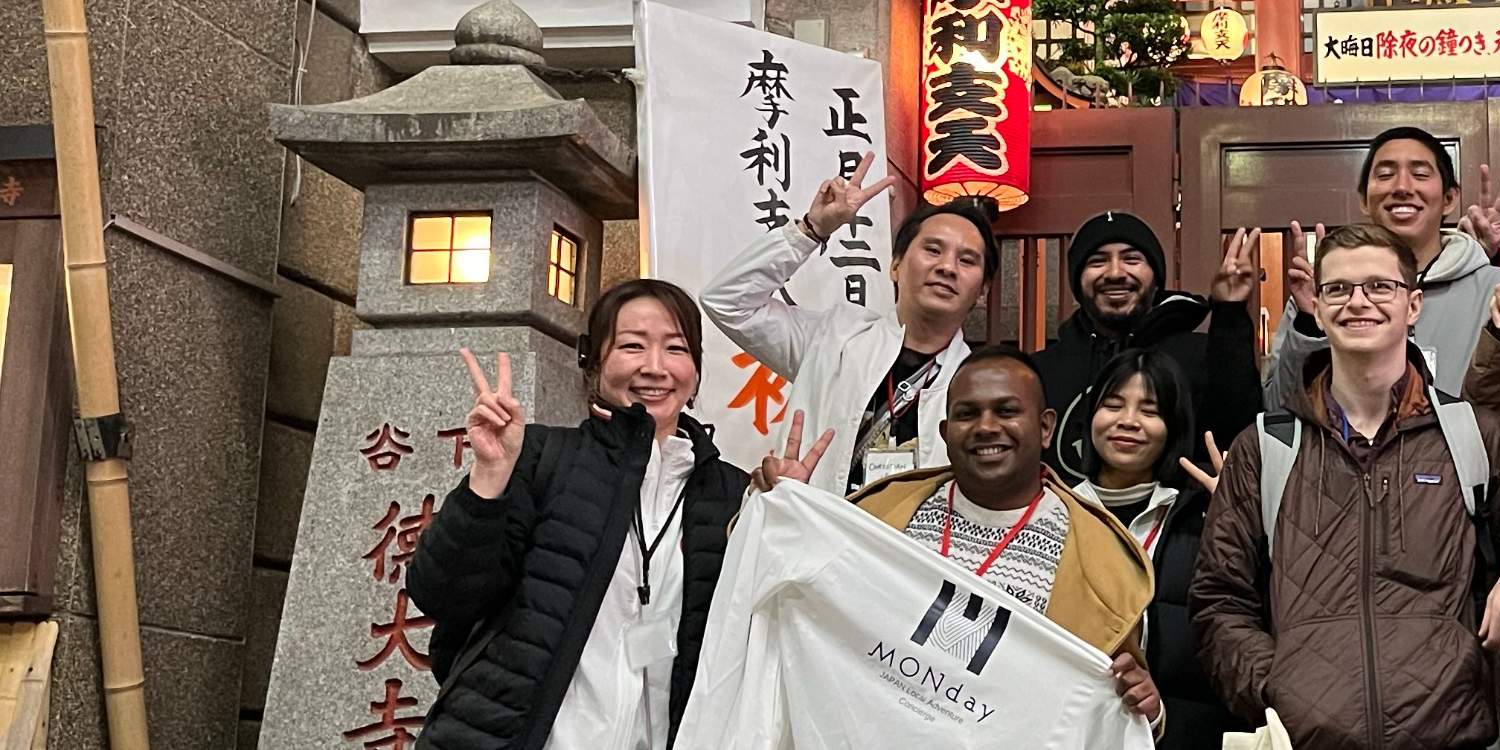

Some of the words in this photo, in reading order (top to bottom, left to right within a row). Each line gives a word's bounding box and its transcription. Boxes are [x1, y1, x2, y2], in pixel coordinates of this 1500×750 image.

[868, 641, 995, 723] MONday
[879, 672, 908, 692] JAPAN
[927, 699, 964, 724] Adventure
[898, 696, 936, 723] Concierge
